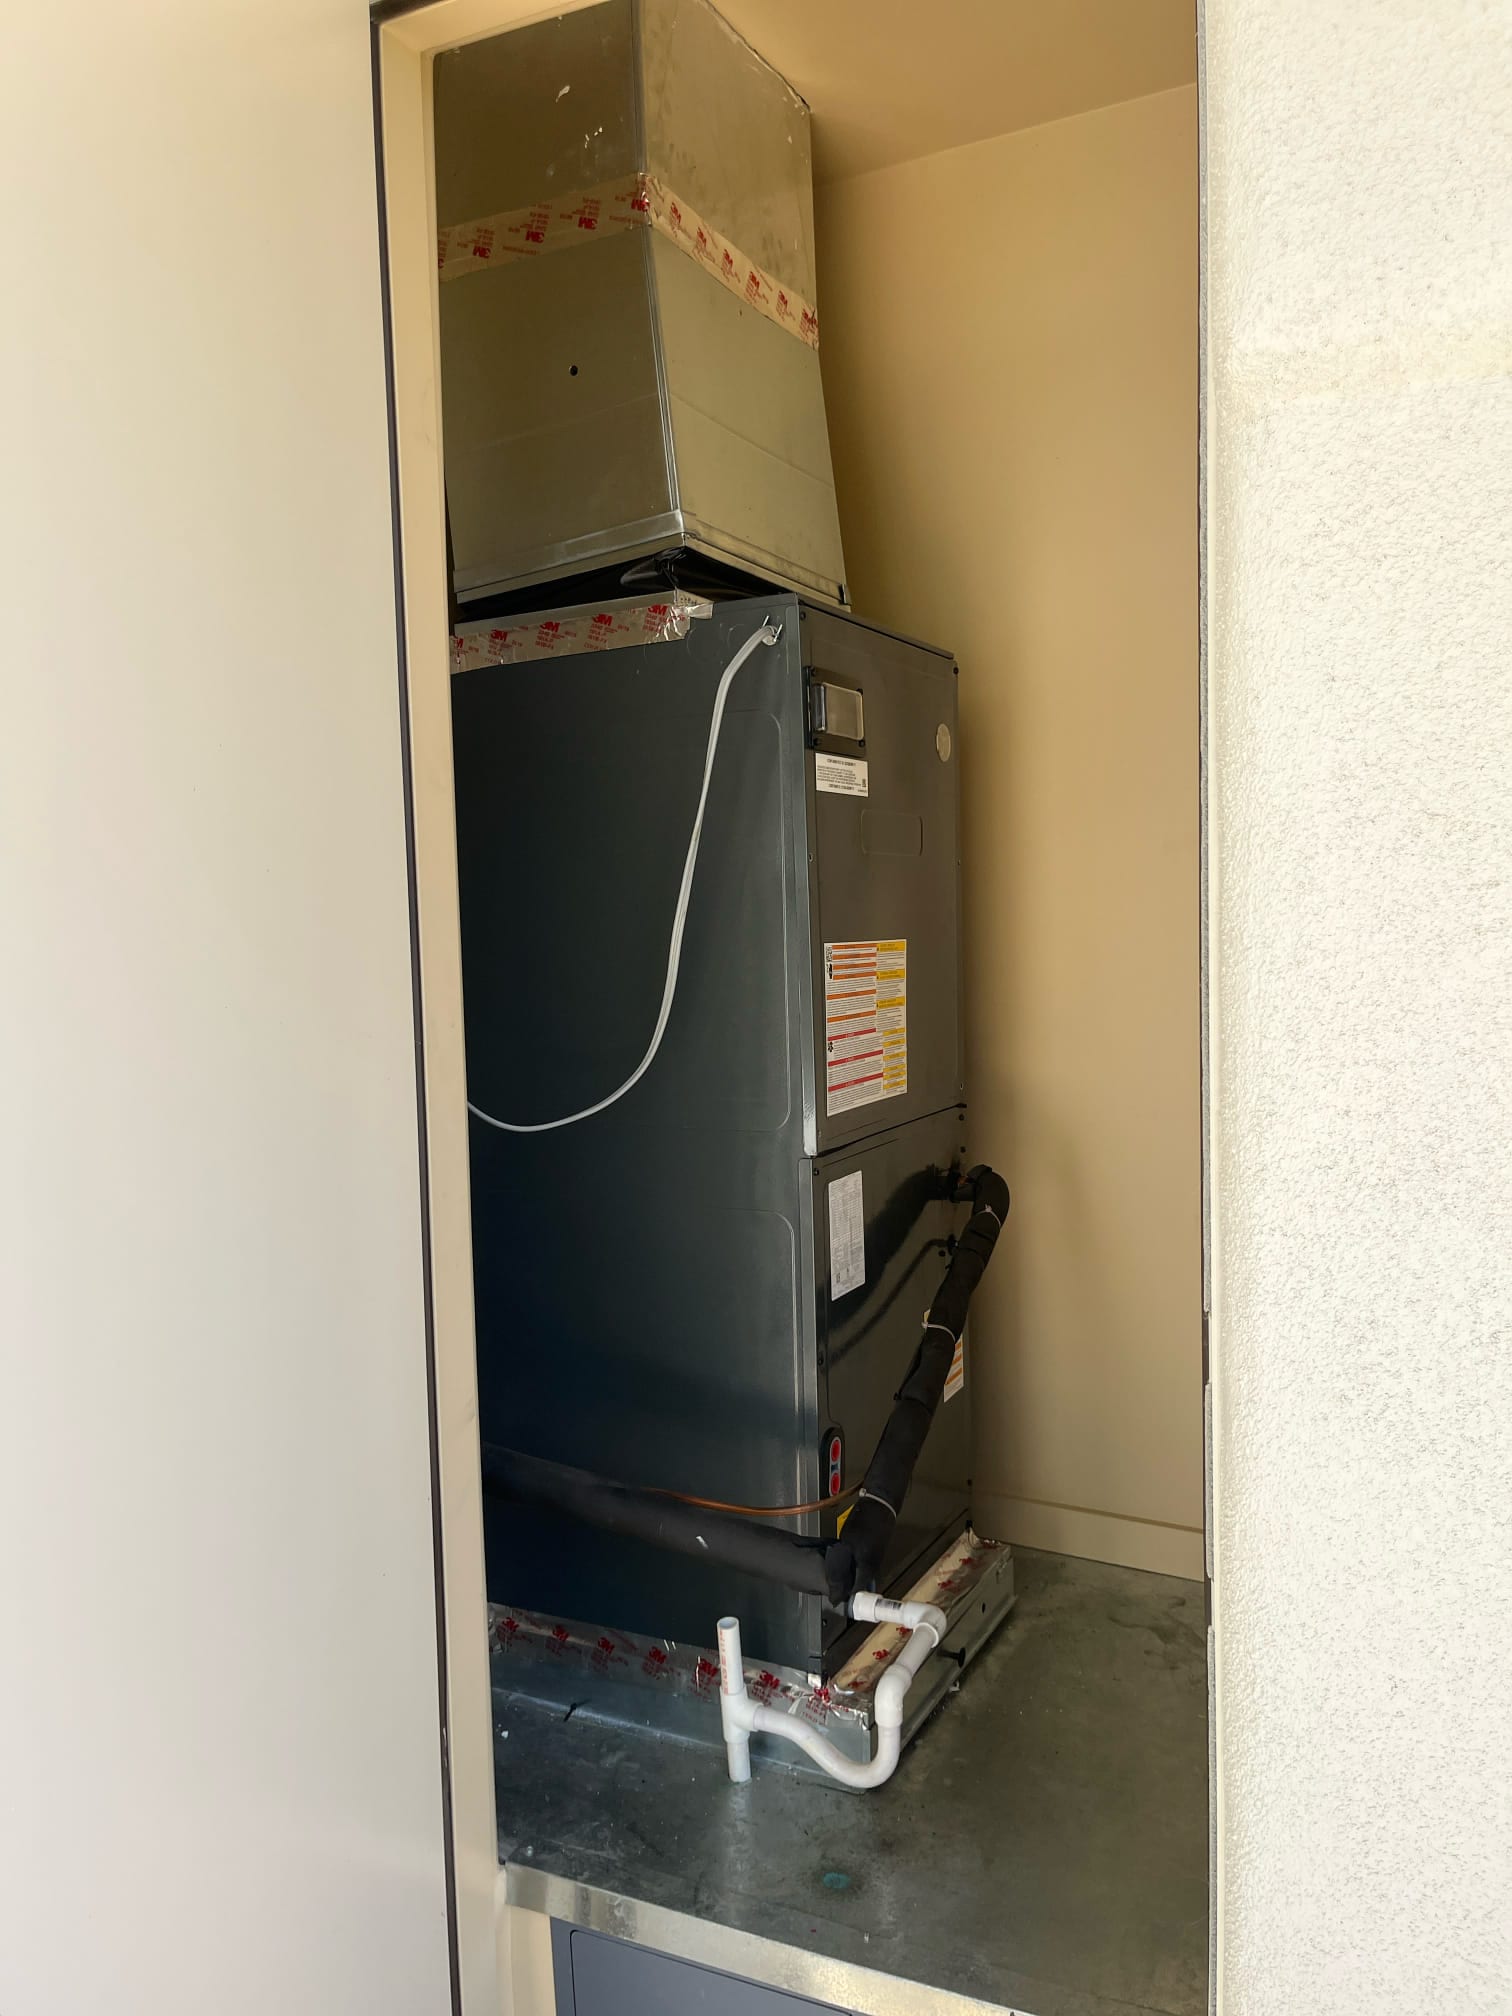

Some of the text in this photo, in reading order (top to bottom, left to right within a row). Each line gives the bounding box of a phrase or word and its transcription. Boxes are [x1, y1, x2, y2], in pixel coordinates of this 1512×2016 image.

[631, 199, 651, 213] 3M
[670, 202, 682, 224] 3M
[578, 216, 599, 231] 3M
[525, 230, 545, 244] 3M
[473, 246, 492, 260] 3M
[750, 271, 761, 294] 3M
[648, 603, 668, 617] 3M
[540, 620, 560, 633] 3M
[592, 613, 613, 627] 3M
[491, 629, 508, 643] 3M
[598, 1637, 615, 1655] 3M
[649, 1646, 667, 1665] 3M
[699, 1657, 719, 1678] 3M
[759, 1669, 780, 1689] 3M
